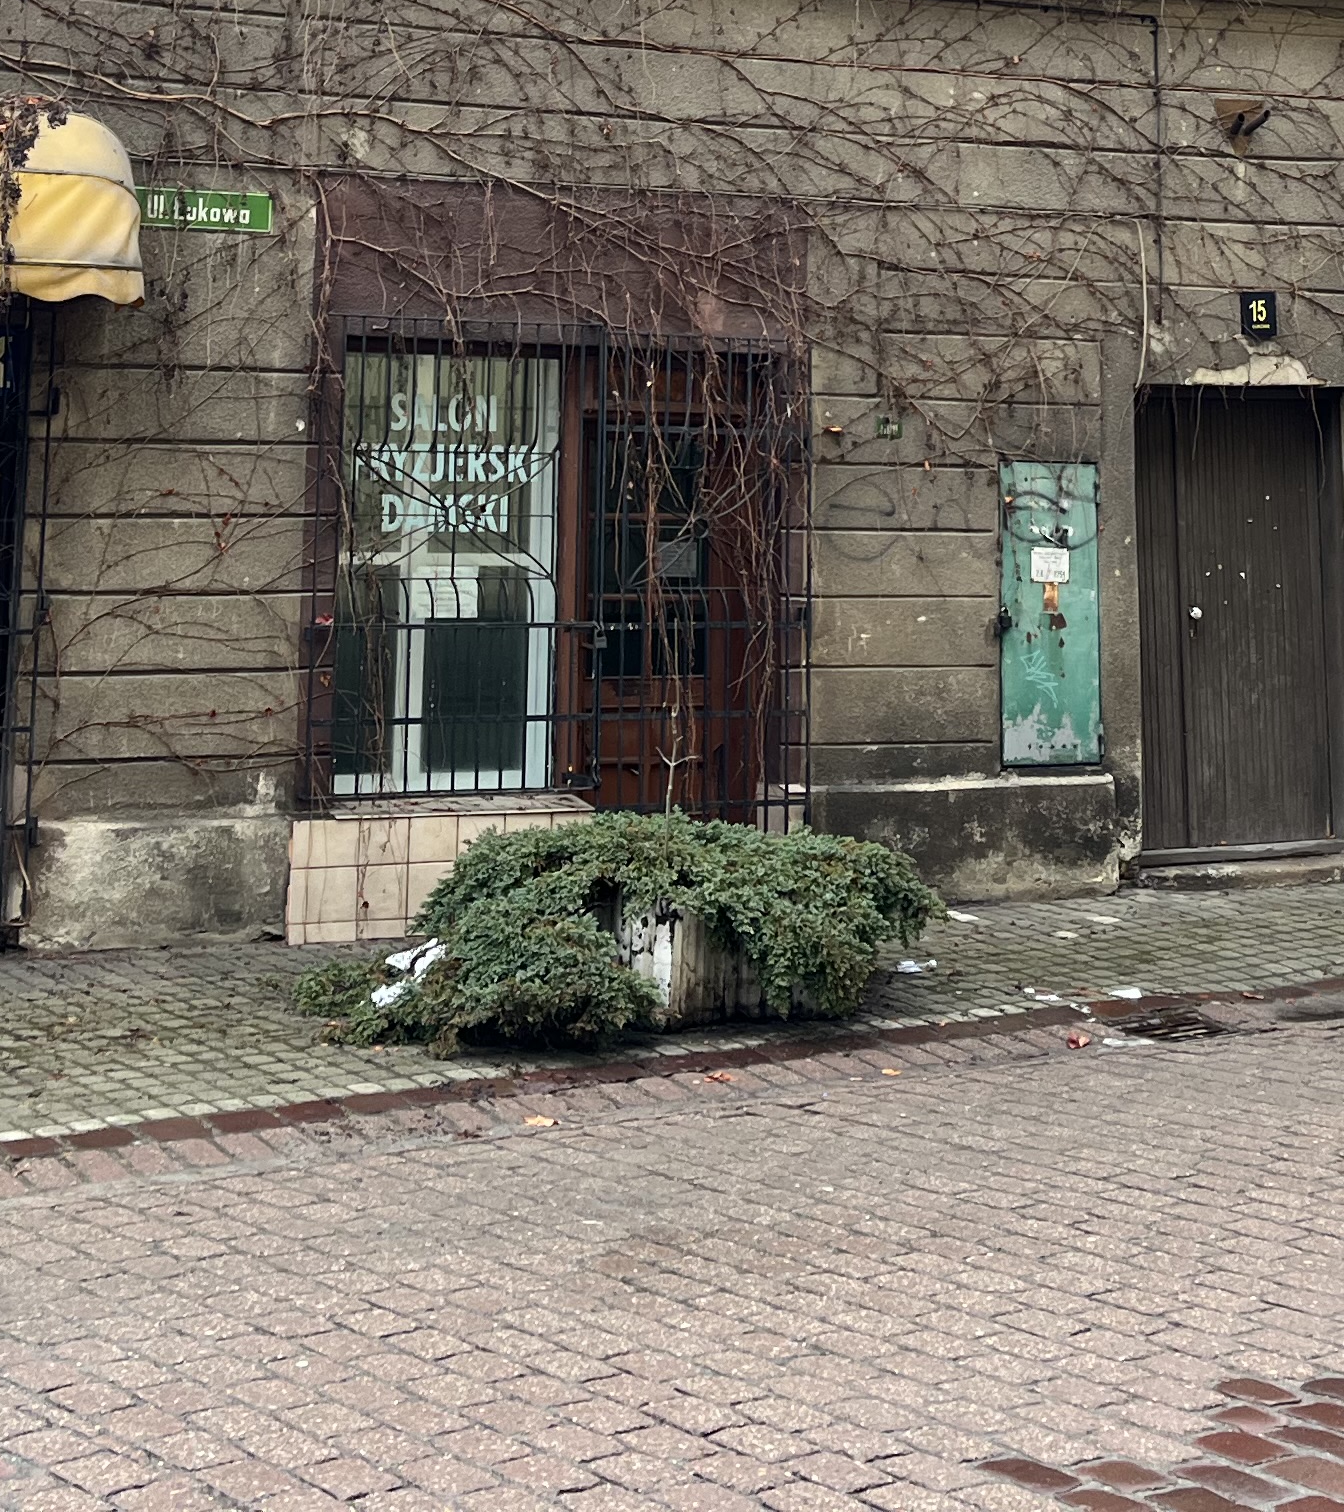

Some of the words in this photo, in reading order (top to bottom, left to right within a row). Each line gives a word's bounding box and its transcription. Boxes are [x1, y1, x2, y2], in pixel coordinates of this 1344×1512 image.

[1249, 299, 1267, 322] 15
[390, 392, 498, 432] SALON
[351, 442, 539, 483] FRYZJERSKI
[381, 494, 509, 533] DAMSKI
